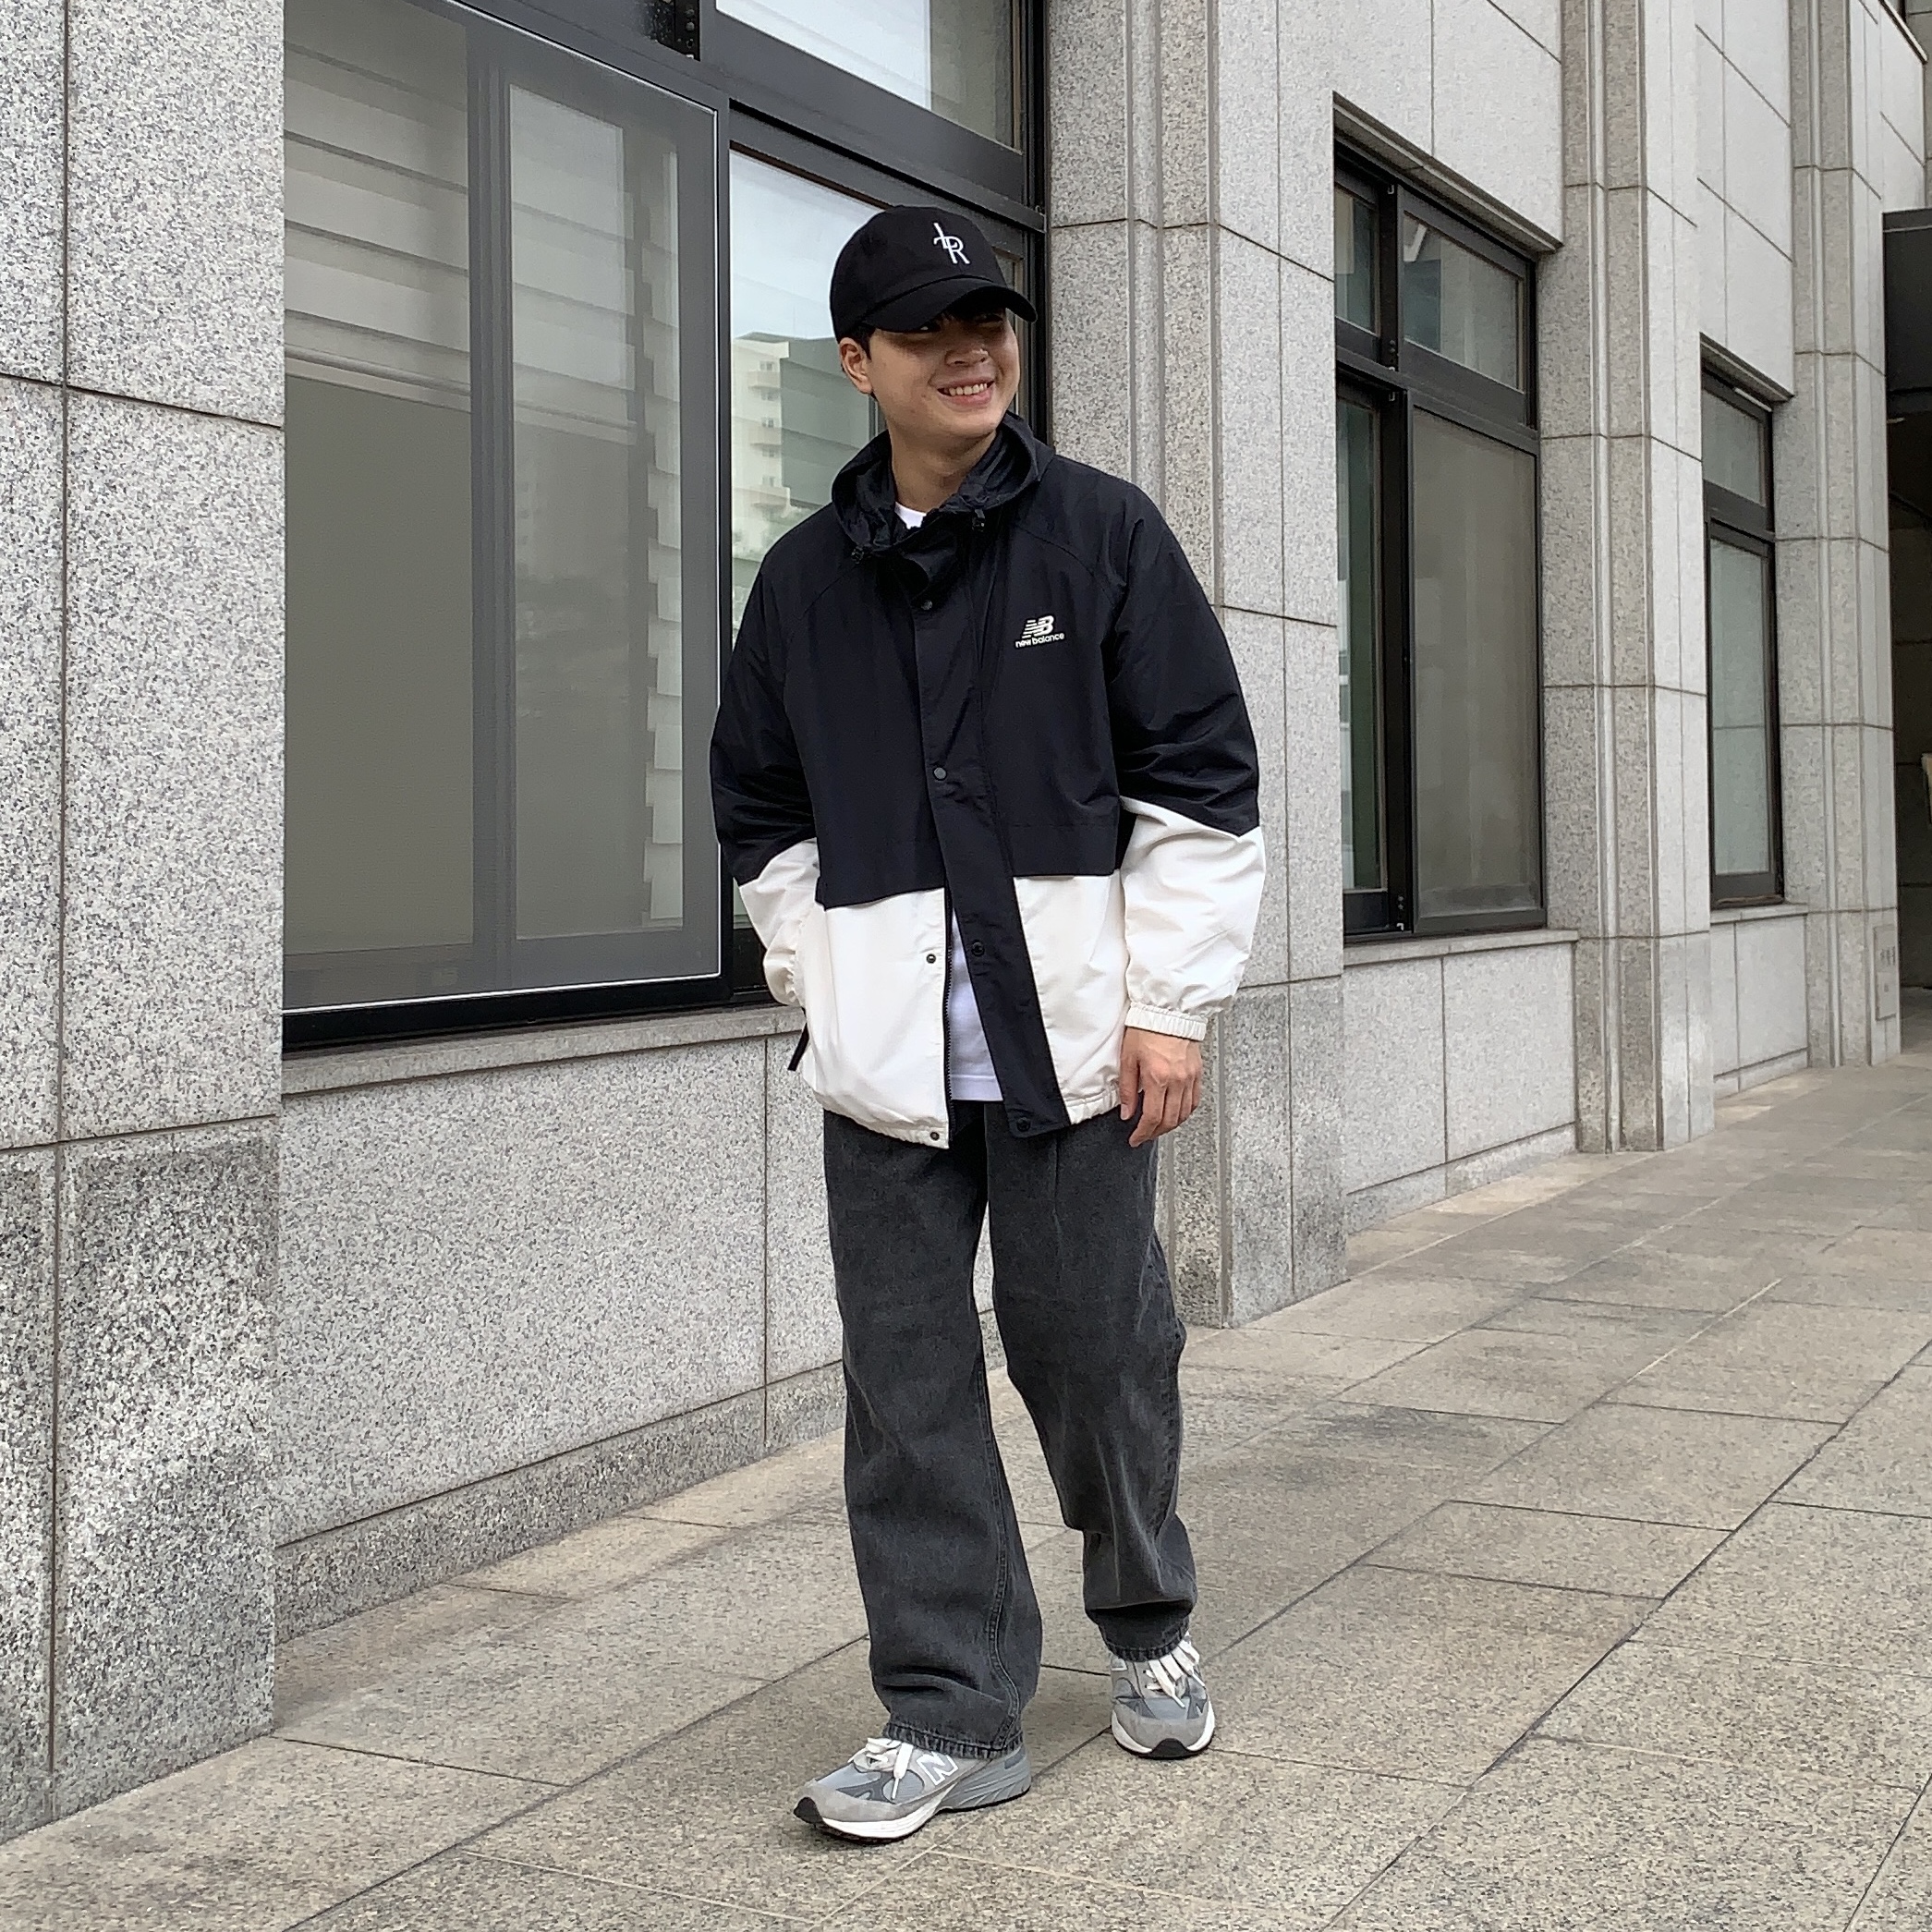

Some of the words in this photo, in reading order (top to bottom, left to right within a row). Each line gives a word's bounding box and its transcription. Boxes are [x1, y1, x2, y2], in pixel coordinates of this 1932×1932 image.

[1015, 639, 1031, 648] new
[1032, 633, 1065, 645] balance
[916, 1751, 959, 1786] N
